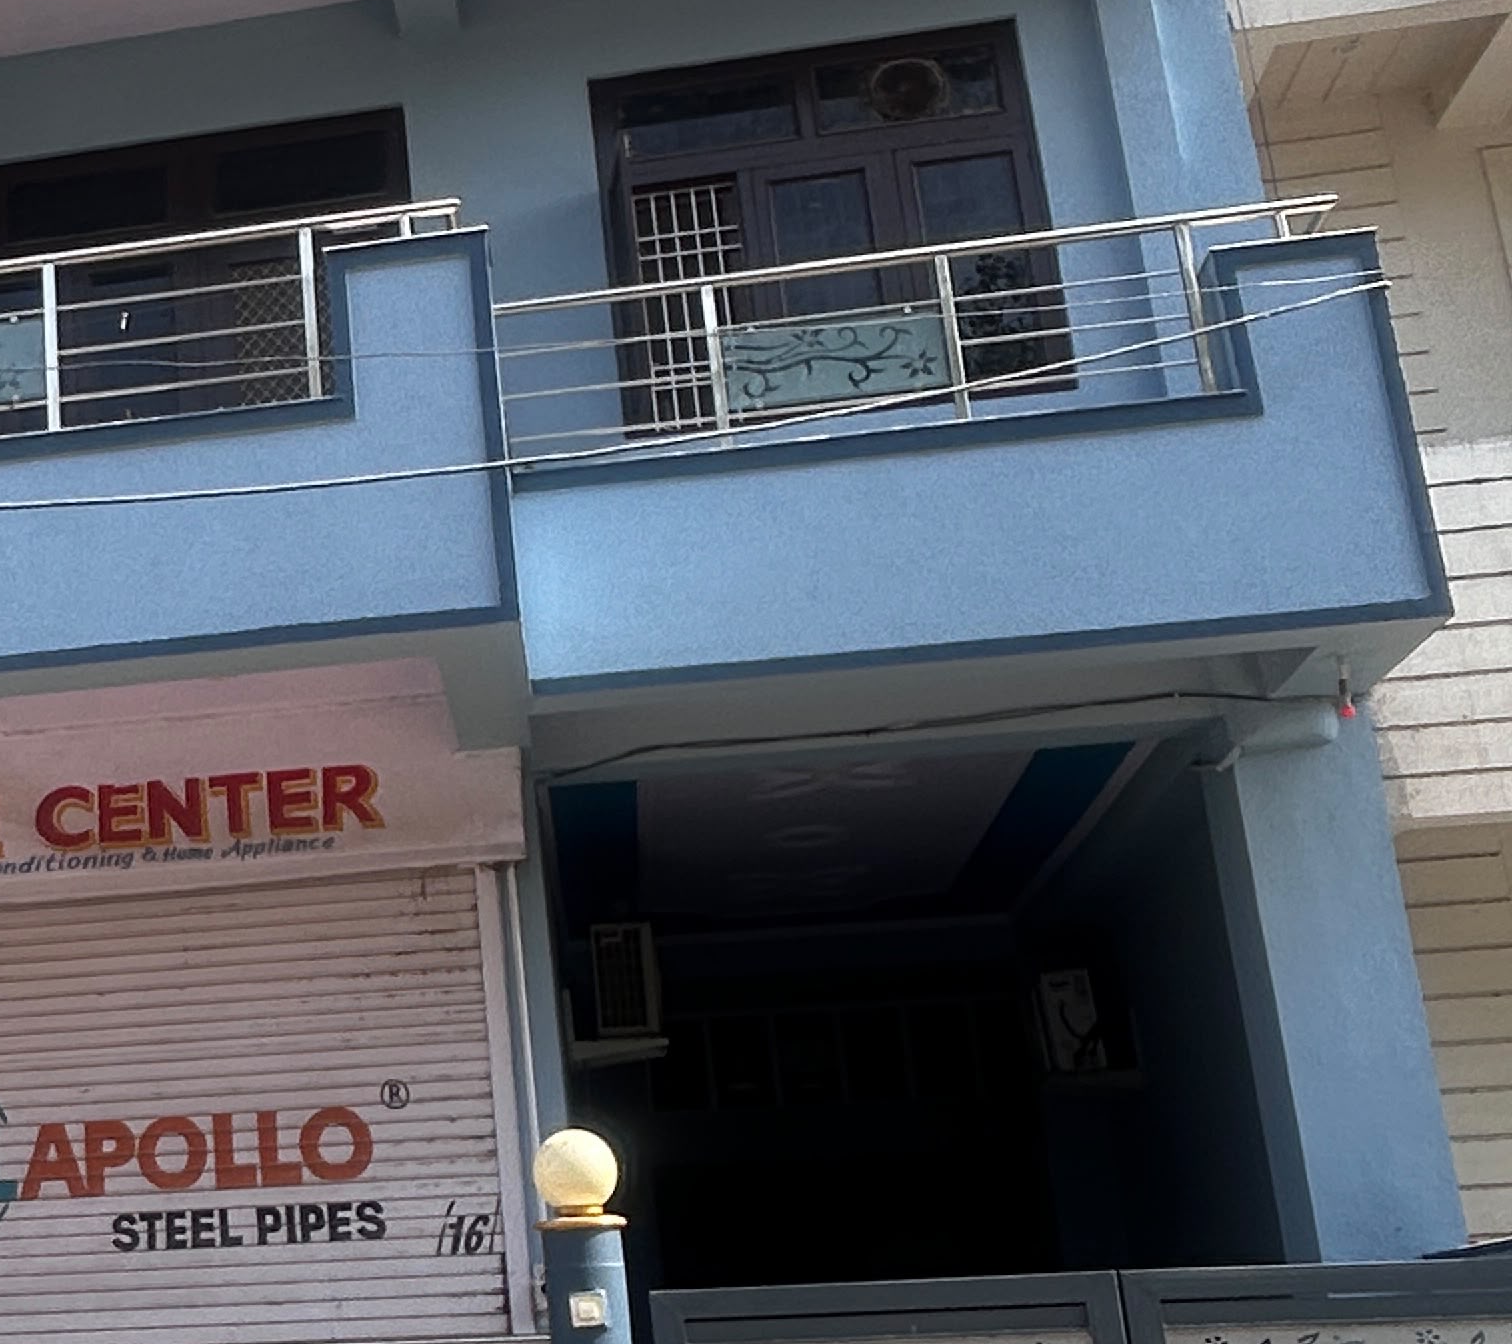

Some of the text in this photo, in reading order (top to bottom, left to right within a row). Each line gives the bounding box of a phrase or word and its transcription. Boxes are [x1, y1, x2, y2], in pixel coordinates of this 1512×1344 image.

[34, 764, 385, 853] CENTER
[221, 836, 336, 862] Appliance
[19, 1106, 374, 1202] APOLLO
[111, 1200, 387, 1253] STEEL PIPES
